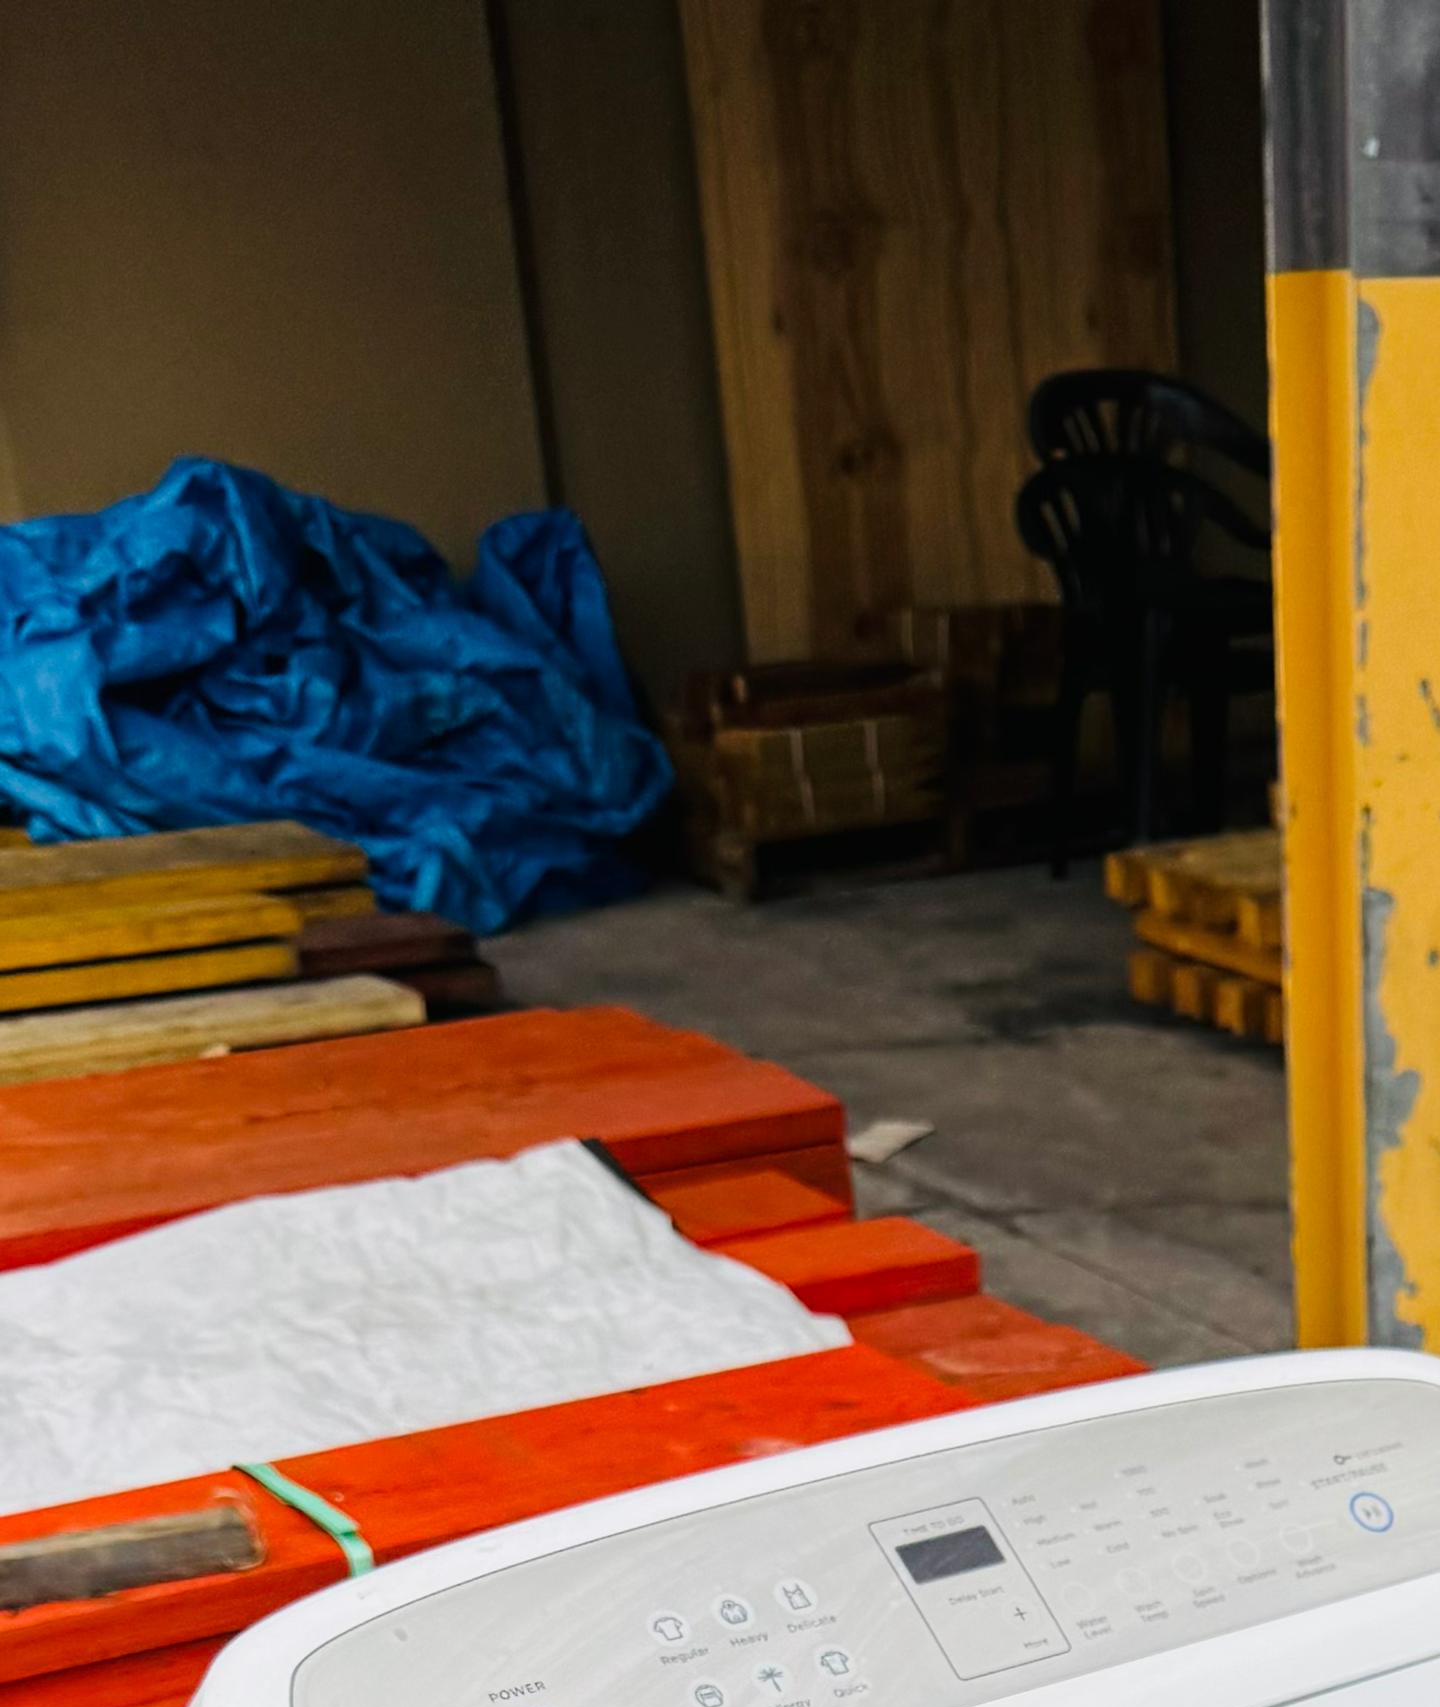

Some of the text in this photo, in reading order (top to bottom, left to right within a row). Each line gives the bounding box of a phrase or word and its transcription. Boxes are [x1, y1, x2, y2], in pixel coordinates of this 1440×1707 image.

[659, 1615, 837, 1666] Regular Heavy Delicate
[488, 1680, 547, 1702] POWER
[833, 1683, 869, 1700] Quick
